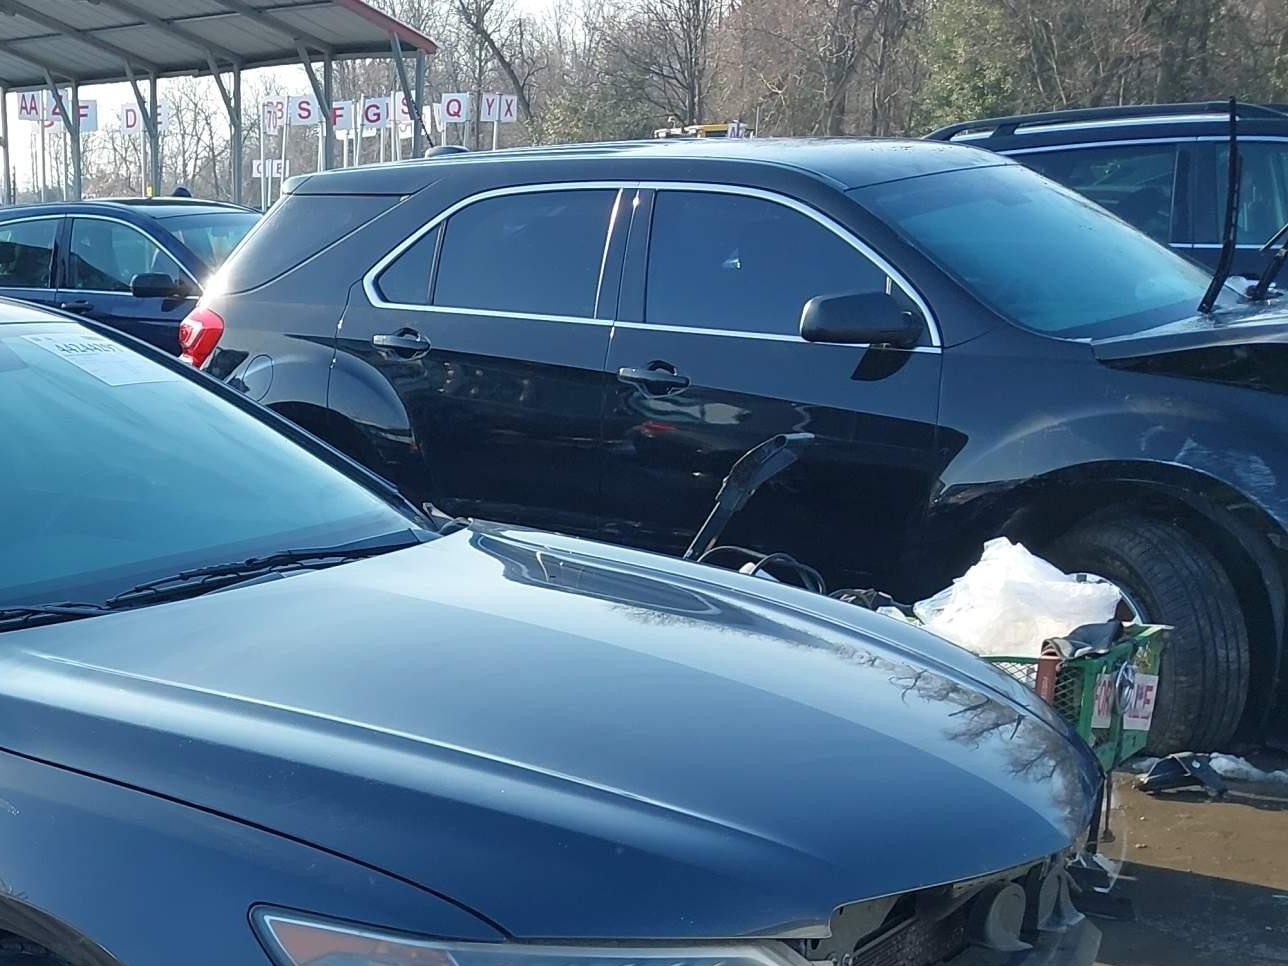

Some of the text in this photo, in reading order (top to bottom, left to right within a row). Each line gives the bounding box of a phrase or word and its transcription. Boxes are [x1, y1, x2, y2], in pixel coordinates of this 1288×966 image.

[19, 93, 38, 115] AA
[297, 100, 312, 119] S
[364, 104, 381, 123] G
[446, 98, 462, 118] Q
[485, 98, 495, 116] Y
[504, 98, 514, 117] X
[125, 108, 137, 128] D
[331, 106, 345, 126] F
